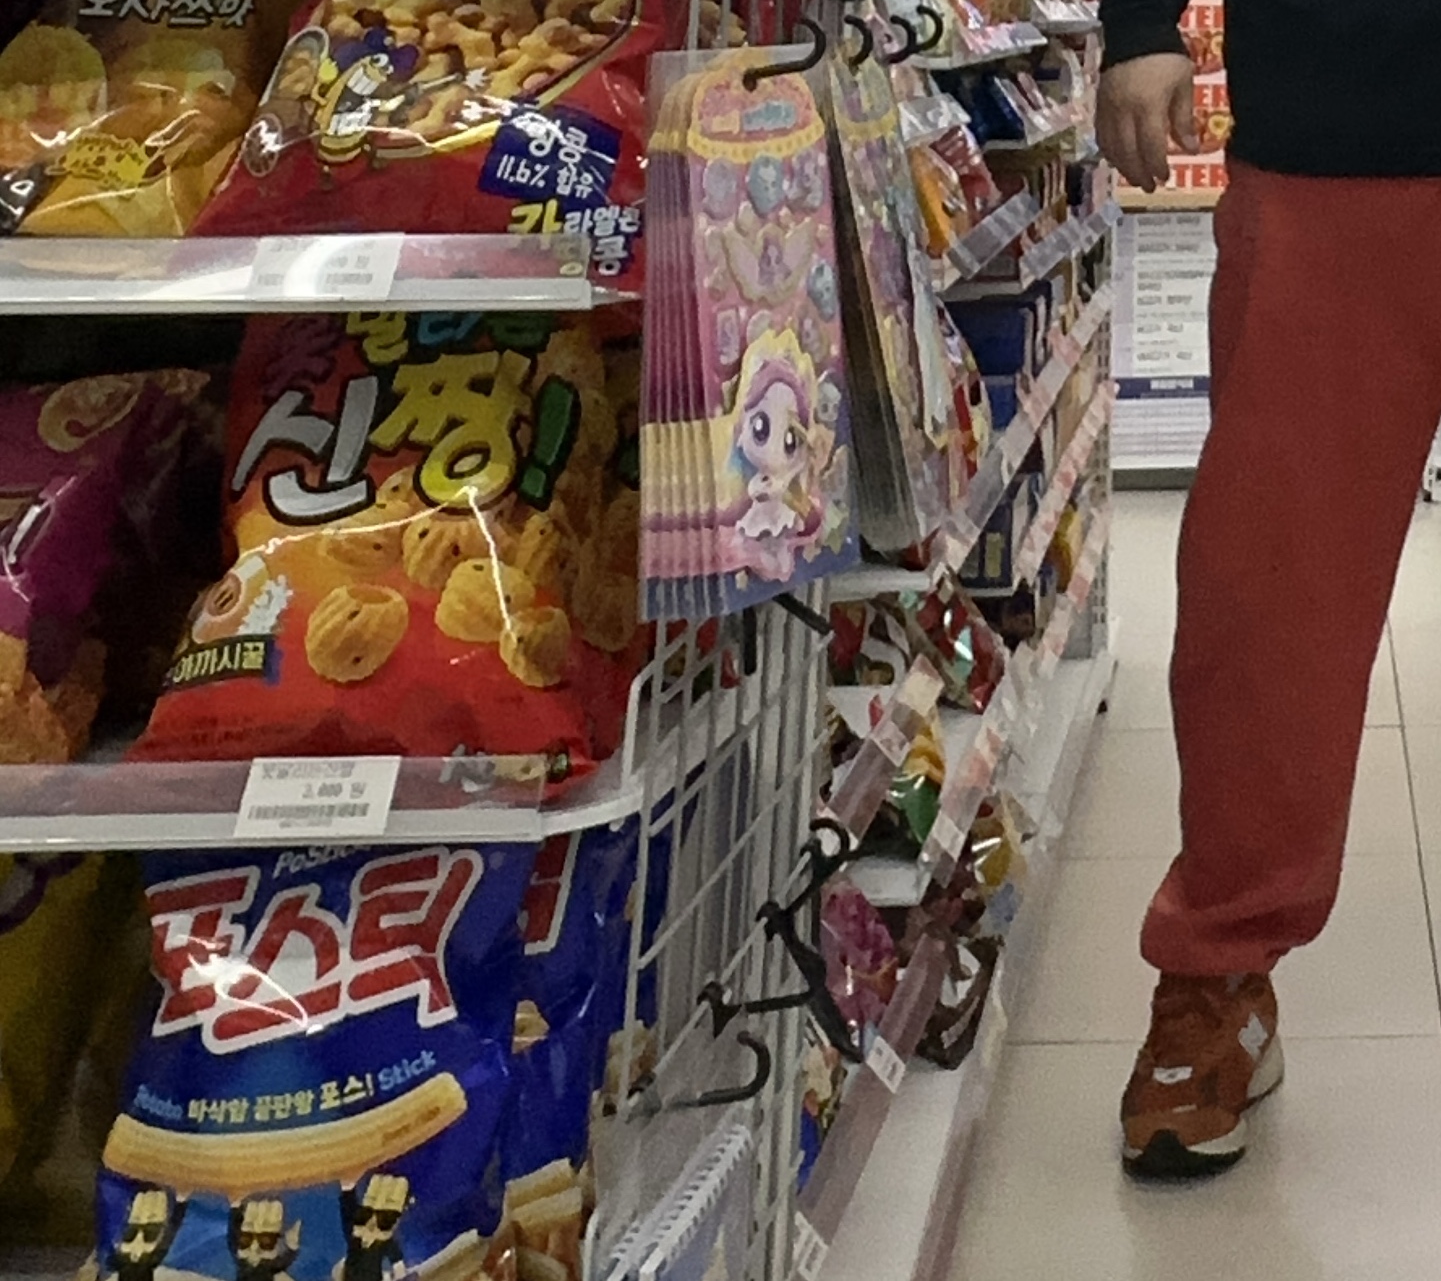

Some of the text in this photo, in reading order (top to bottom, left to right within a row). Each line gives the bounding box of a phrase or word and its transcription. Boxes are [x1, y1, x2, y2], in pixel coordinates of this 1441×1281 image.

[496, 153, 550, 188] 11.6%
[145, 846, 483, 1055] 포스틱
[376, 1047, 438, 1093] Stick
